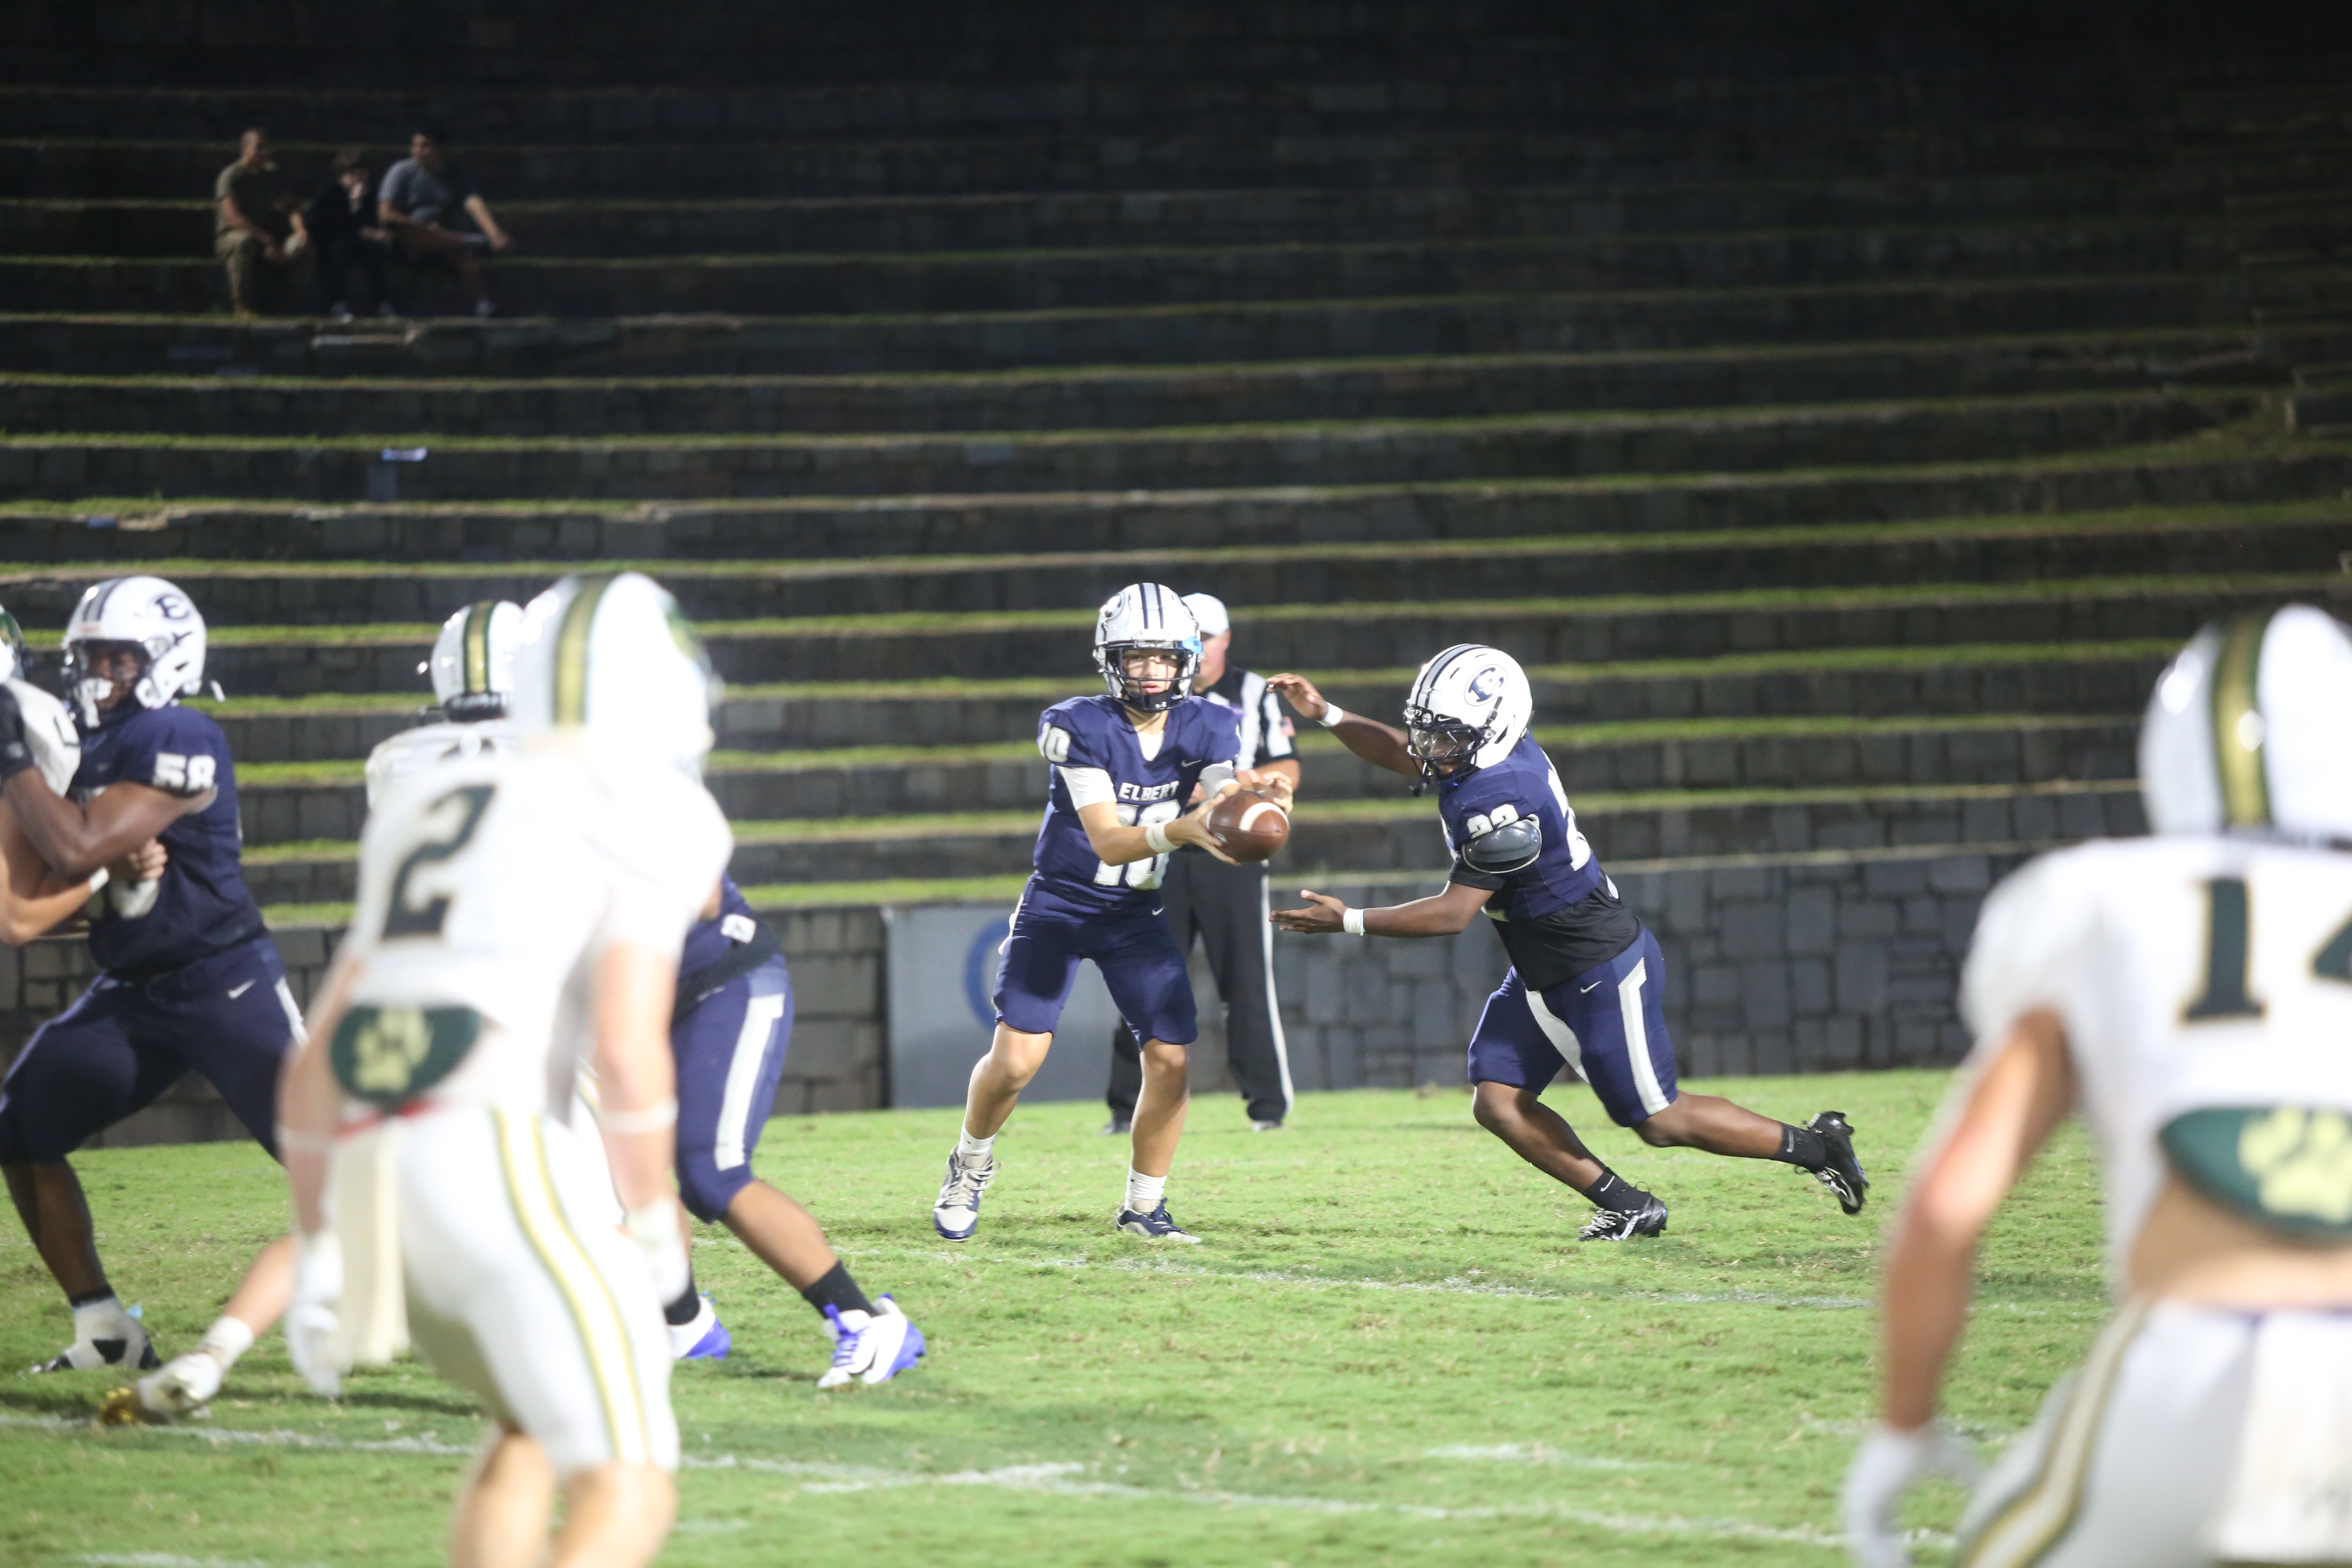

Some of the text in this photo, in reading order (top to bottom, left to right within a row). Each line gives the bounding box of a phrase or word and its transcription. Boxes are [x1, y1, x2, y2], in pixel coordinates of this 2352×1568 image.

[1037, 722, 1071, 762] 10
[152, 752, 216, 791] 58
[1118, 780, 1180, 801] ELBERT
[381, 783, 497, 942] 2
[1093, 799, 1181, 890] 10
